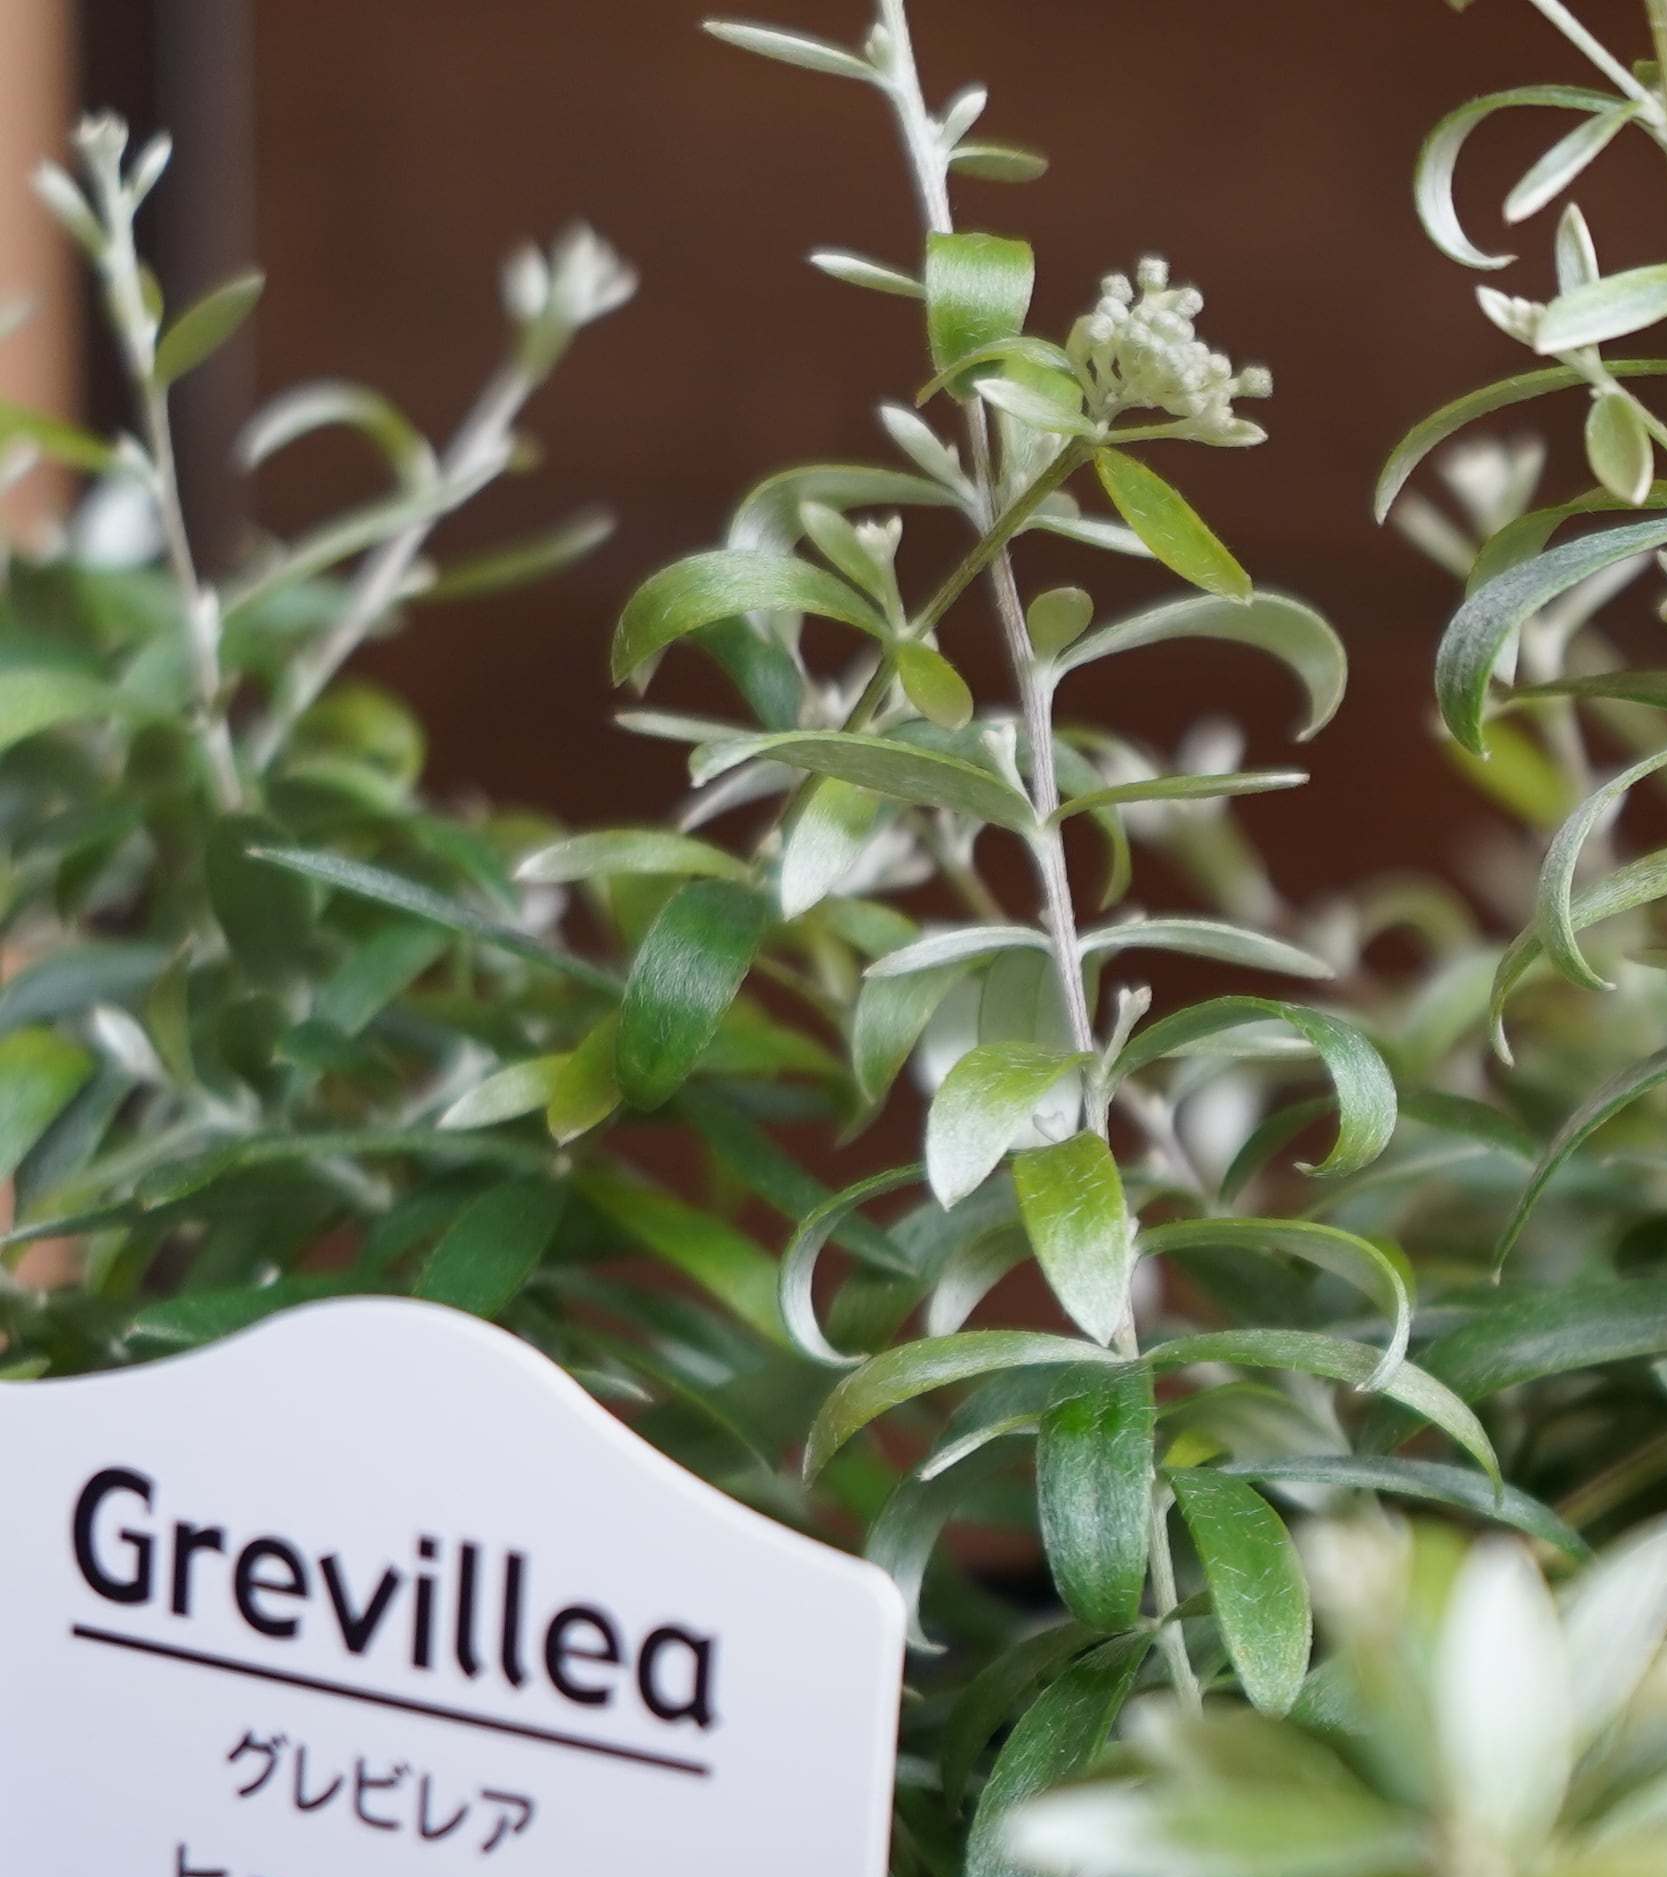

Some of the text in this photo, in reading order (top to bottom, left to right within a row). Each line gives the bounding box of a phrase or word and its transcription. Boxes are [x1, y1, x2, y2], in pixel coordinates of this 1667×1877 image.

[70, 1467, 719, 1731] Grevillea
[227, 1731, 535, 1854] グレビレア
